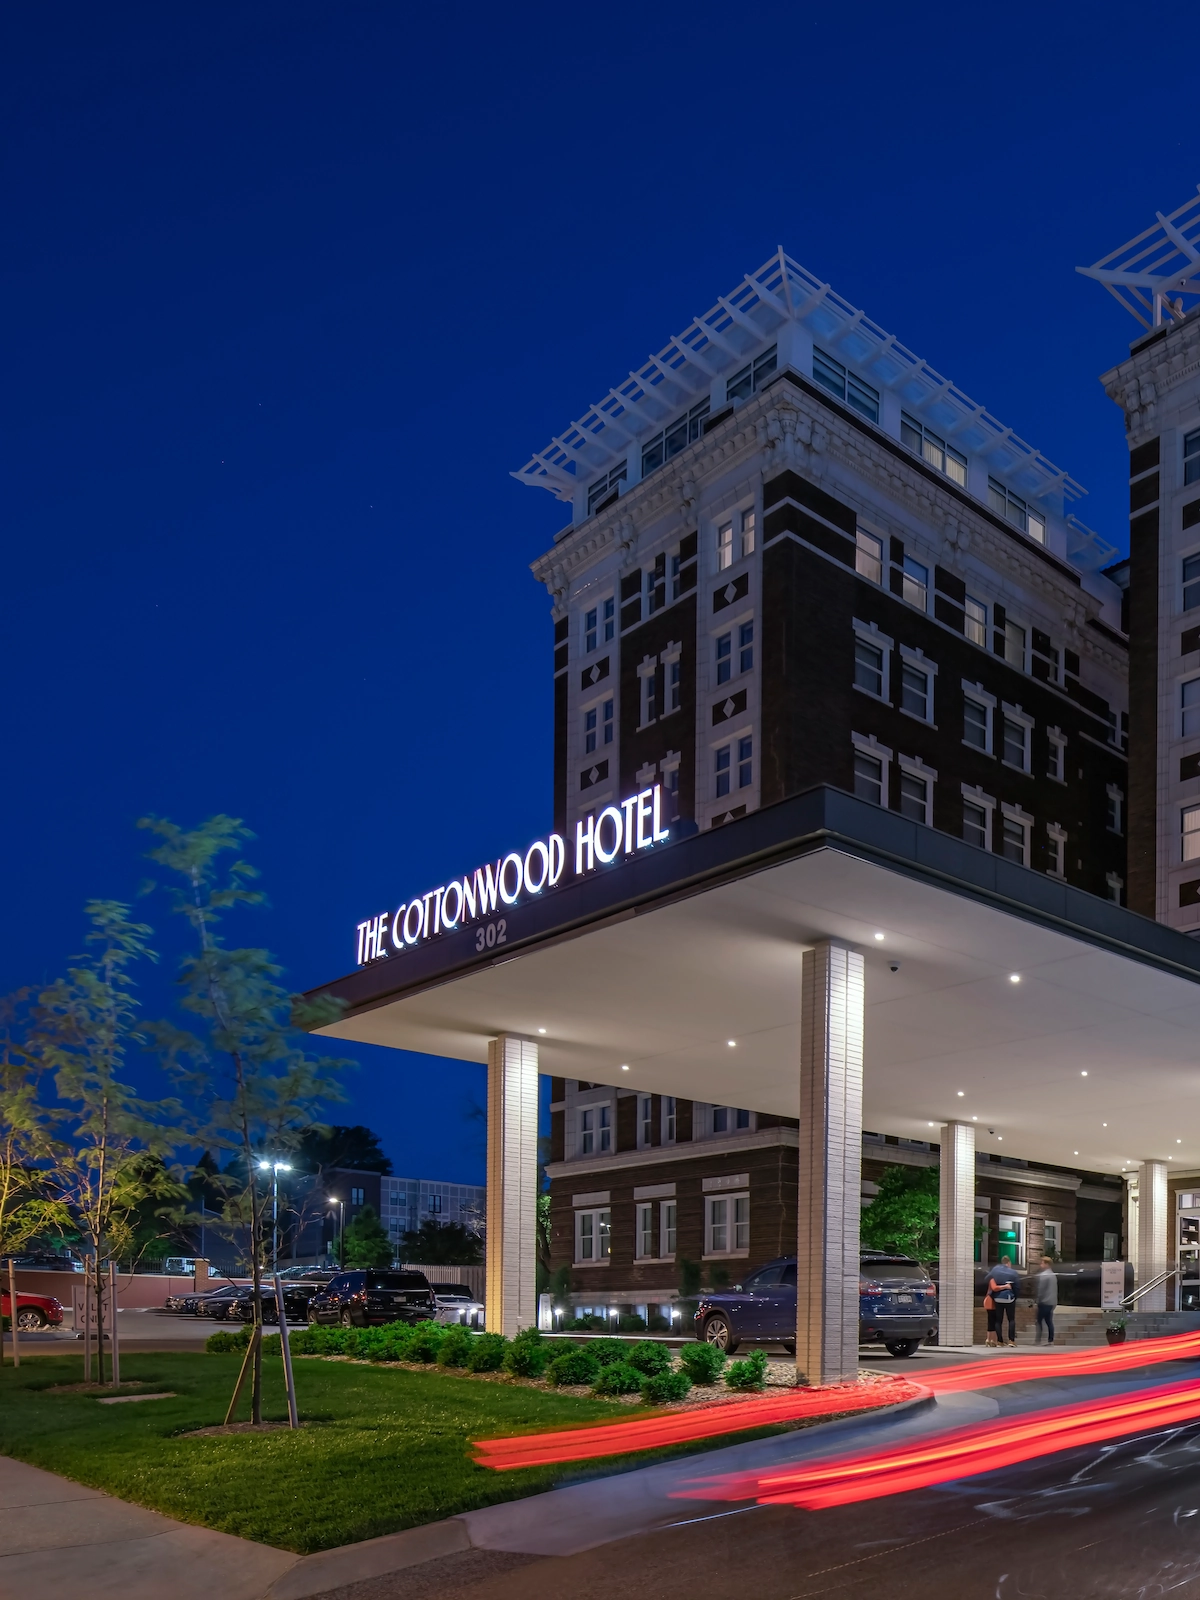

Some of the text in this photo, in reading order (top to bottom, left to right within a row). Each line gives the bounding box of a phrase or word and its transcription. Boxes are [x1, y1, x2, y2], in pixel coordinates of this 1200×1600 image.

[356, 784, 669, 965] THE COTTONWOOD HOTEL
[475, 918, 507, 952] 302
[78, 1303, 109, 1311] VLT
